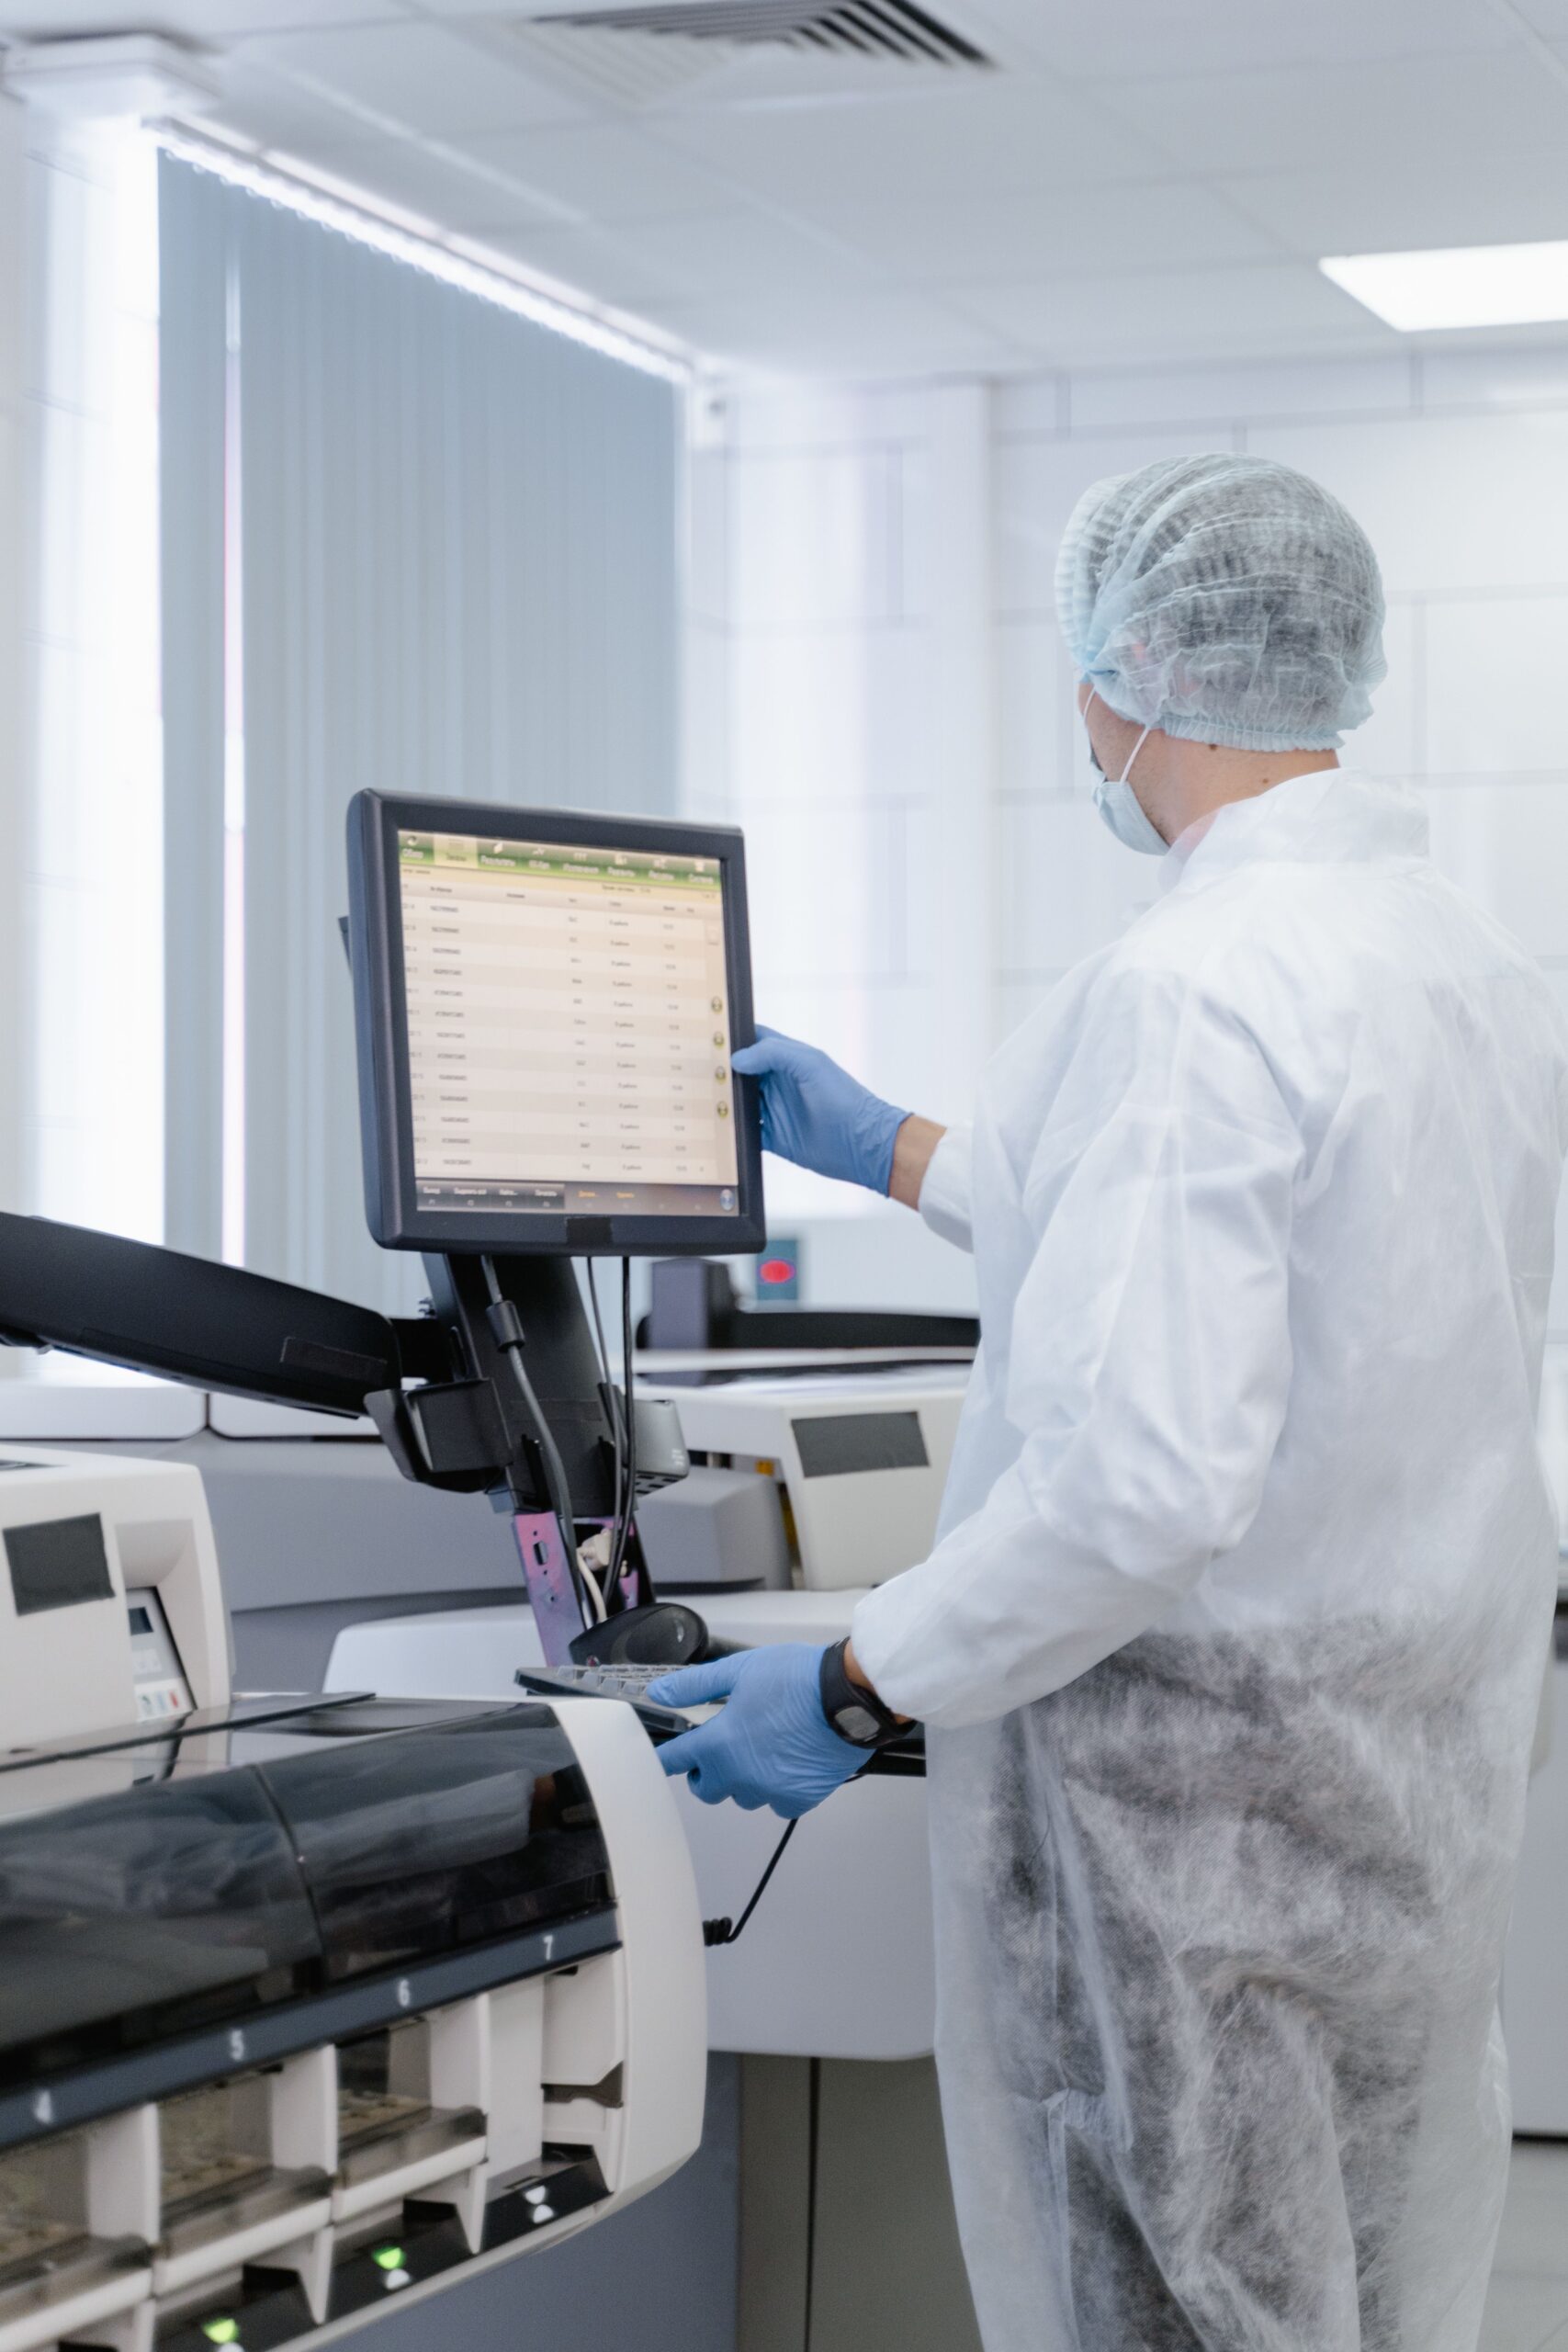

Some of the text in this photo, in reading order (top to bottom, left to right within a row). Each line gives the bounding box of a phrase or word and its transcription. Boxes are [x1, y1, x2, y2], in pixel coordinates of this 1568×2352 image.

[543, 1934, 554, 1961] 7
[398, 1979, 411, 2007] 6
[230, 2030, 244, 2062] 5
[33, 2090, 52, 2124] 4
